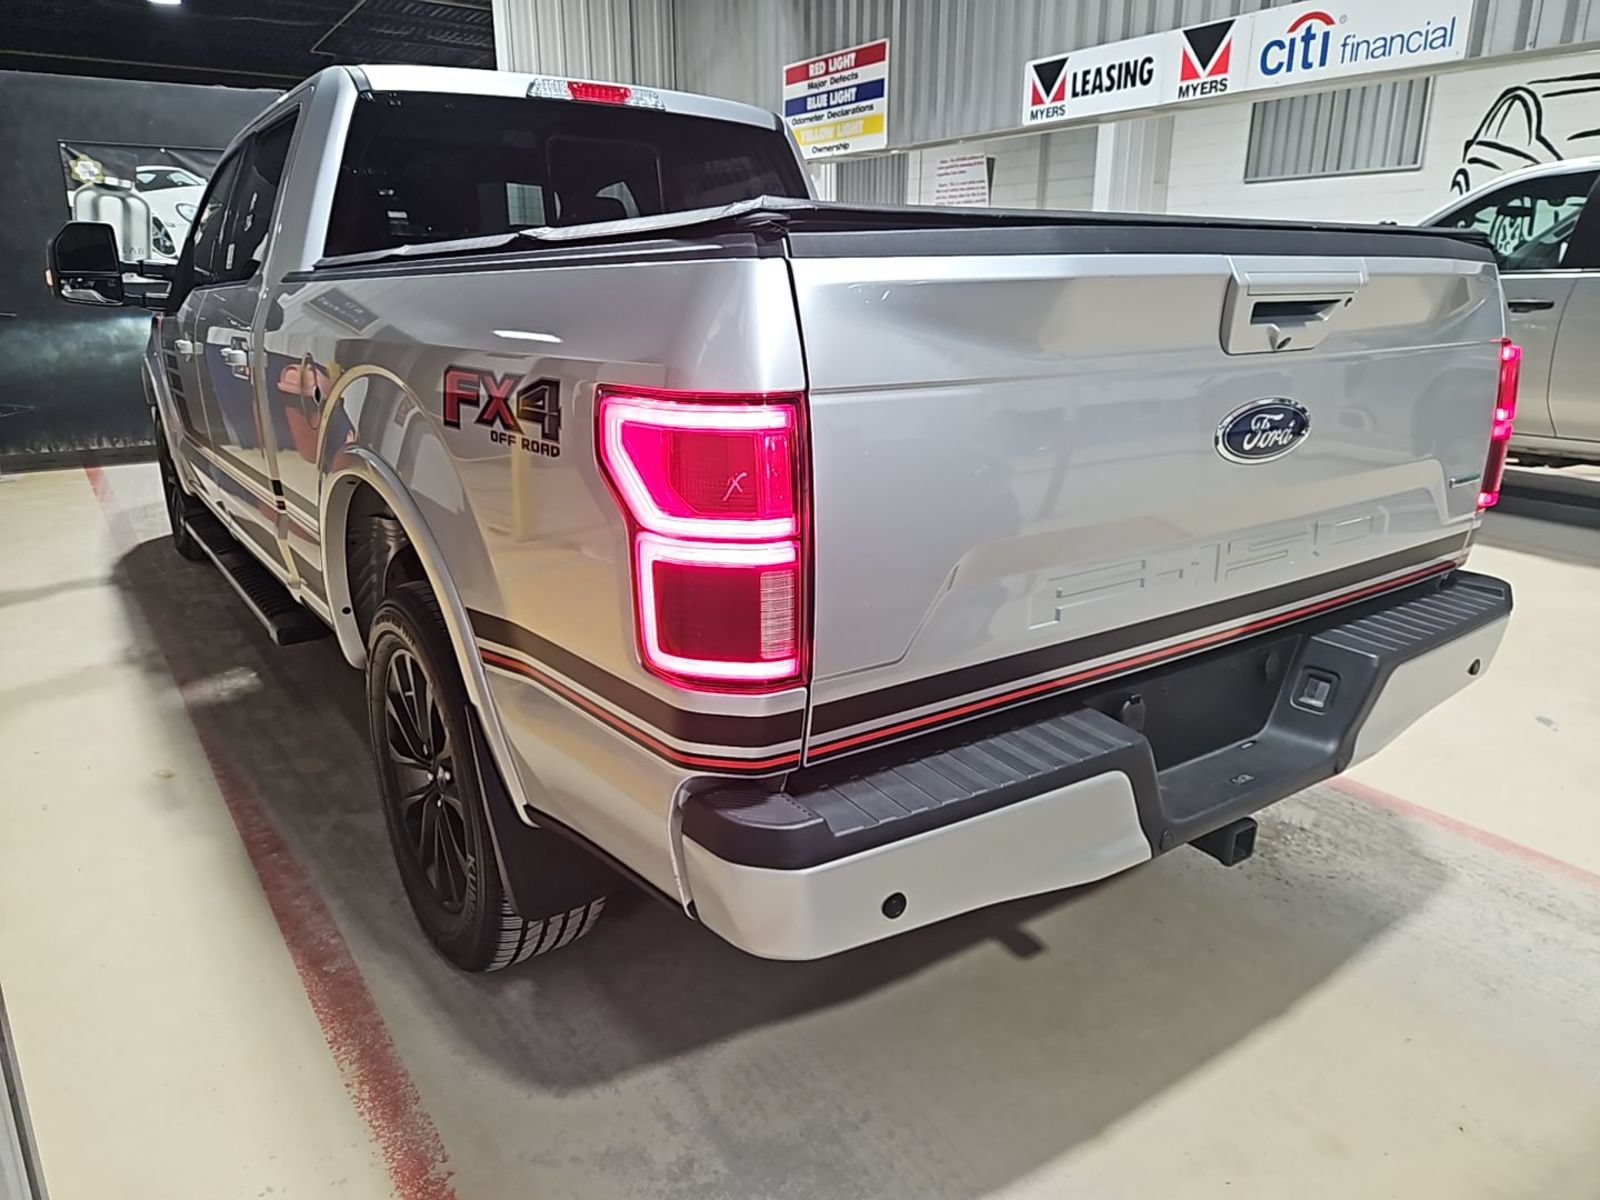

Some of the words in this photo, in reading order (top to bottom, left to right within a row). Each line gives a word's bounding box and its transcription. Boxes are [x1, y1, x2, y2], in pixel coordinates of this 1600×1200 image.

[1260, 23, 1331, 77] citi
[1341, 16, 1457, 64] financial
[809, 62, 826, 78] RED
[828, 53, 856, 73] LIGHT
[1071, 56, 1154, 98] LEASING
[807, 79, 828, 91] Major
[830, 73, 858, 84] Defects
[1178, 77, 1229, 99] MYERS
[806, 94, 828, 110] BLUE
[829, 87, 856, 105] LIGHT
[792, 114, 824, 125] Odometer
[827, 104, 873, 118] Declarations
[1030, 104, 1066, 121] MYERS
[812, 143, 849, 153] Ownership
[443, 365, 562, 443] FX4
[490, 430, 516, 447] OFF
[521, 438, 560, 458] ROAD
[1243, 413, 1295, 451] Ford
